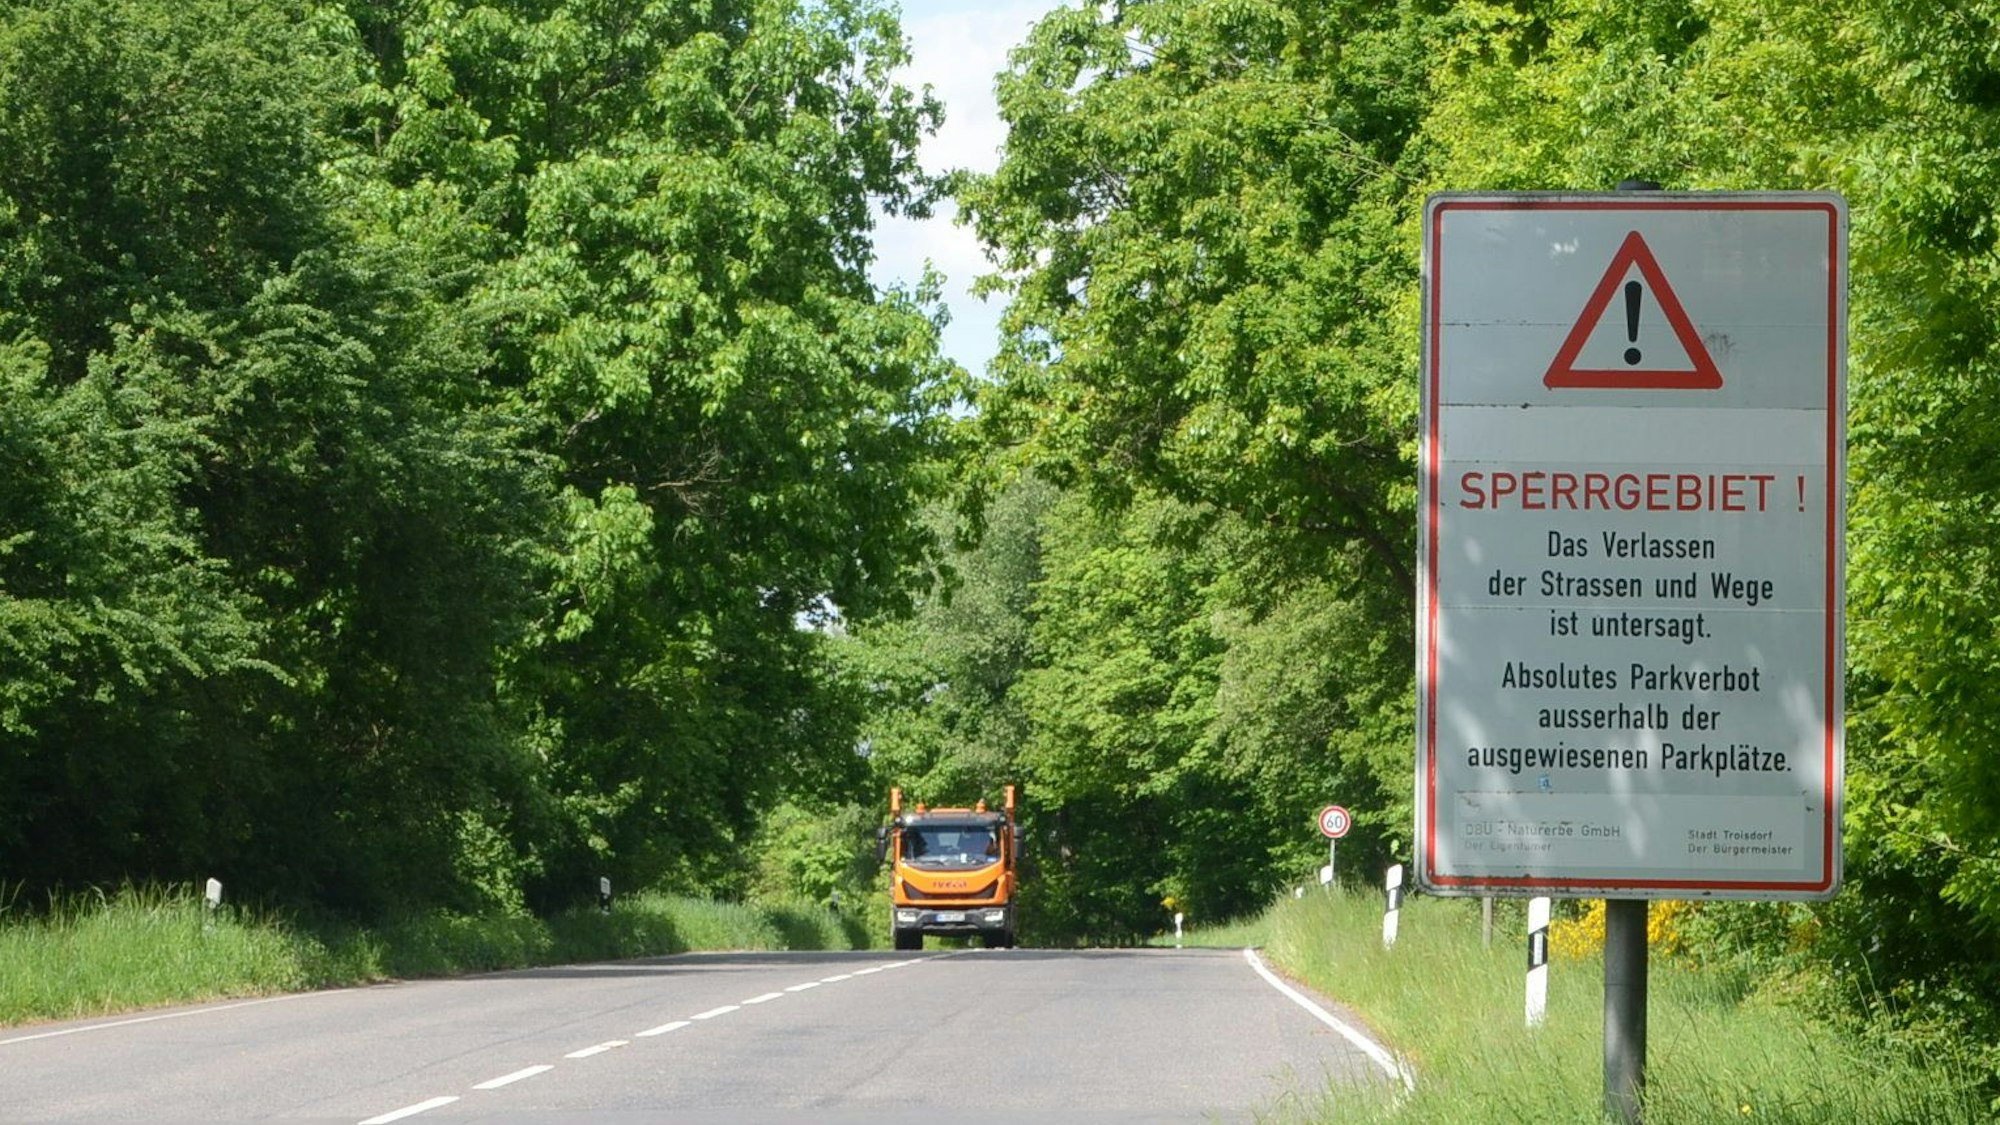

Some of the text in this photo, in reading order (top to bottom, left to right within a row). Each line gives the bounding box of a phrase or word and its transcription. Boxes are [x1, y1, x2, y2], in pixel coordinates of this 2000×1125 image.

[1459, 471, 1806, 512] SPERRGEBIET !
[1548, 531, 1716, 559] Das Verlassen
[1488, 570, 1774, 606] der Strassen und Wege
[1550, 610, 1712, 645] ist untersagt.
[1502, 662, 1760, 692] Absolutes Parkverbot
[1538, 703, 1721, 731] ausserhalb der
[1467, 741, 1792, 777] ausgewiesenen Parkplätze.
[1326, 815, 1343, 829] 60
[1507, 823, 1574, 837] Naturerbe
[1580, 824, 1621, 838] GmbH
[1688, 829, 1773, 840] Stadt Troisdorf
[1688, 843, 1707, 854] Der
